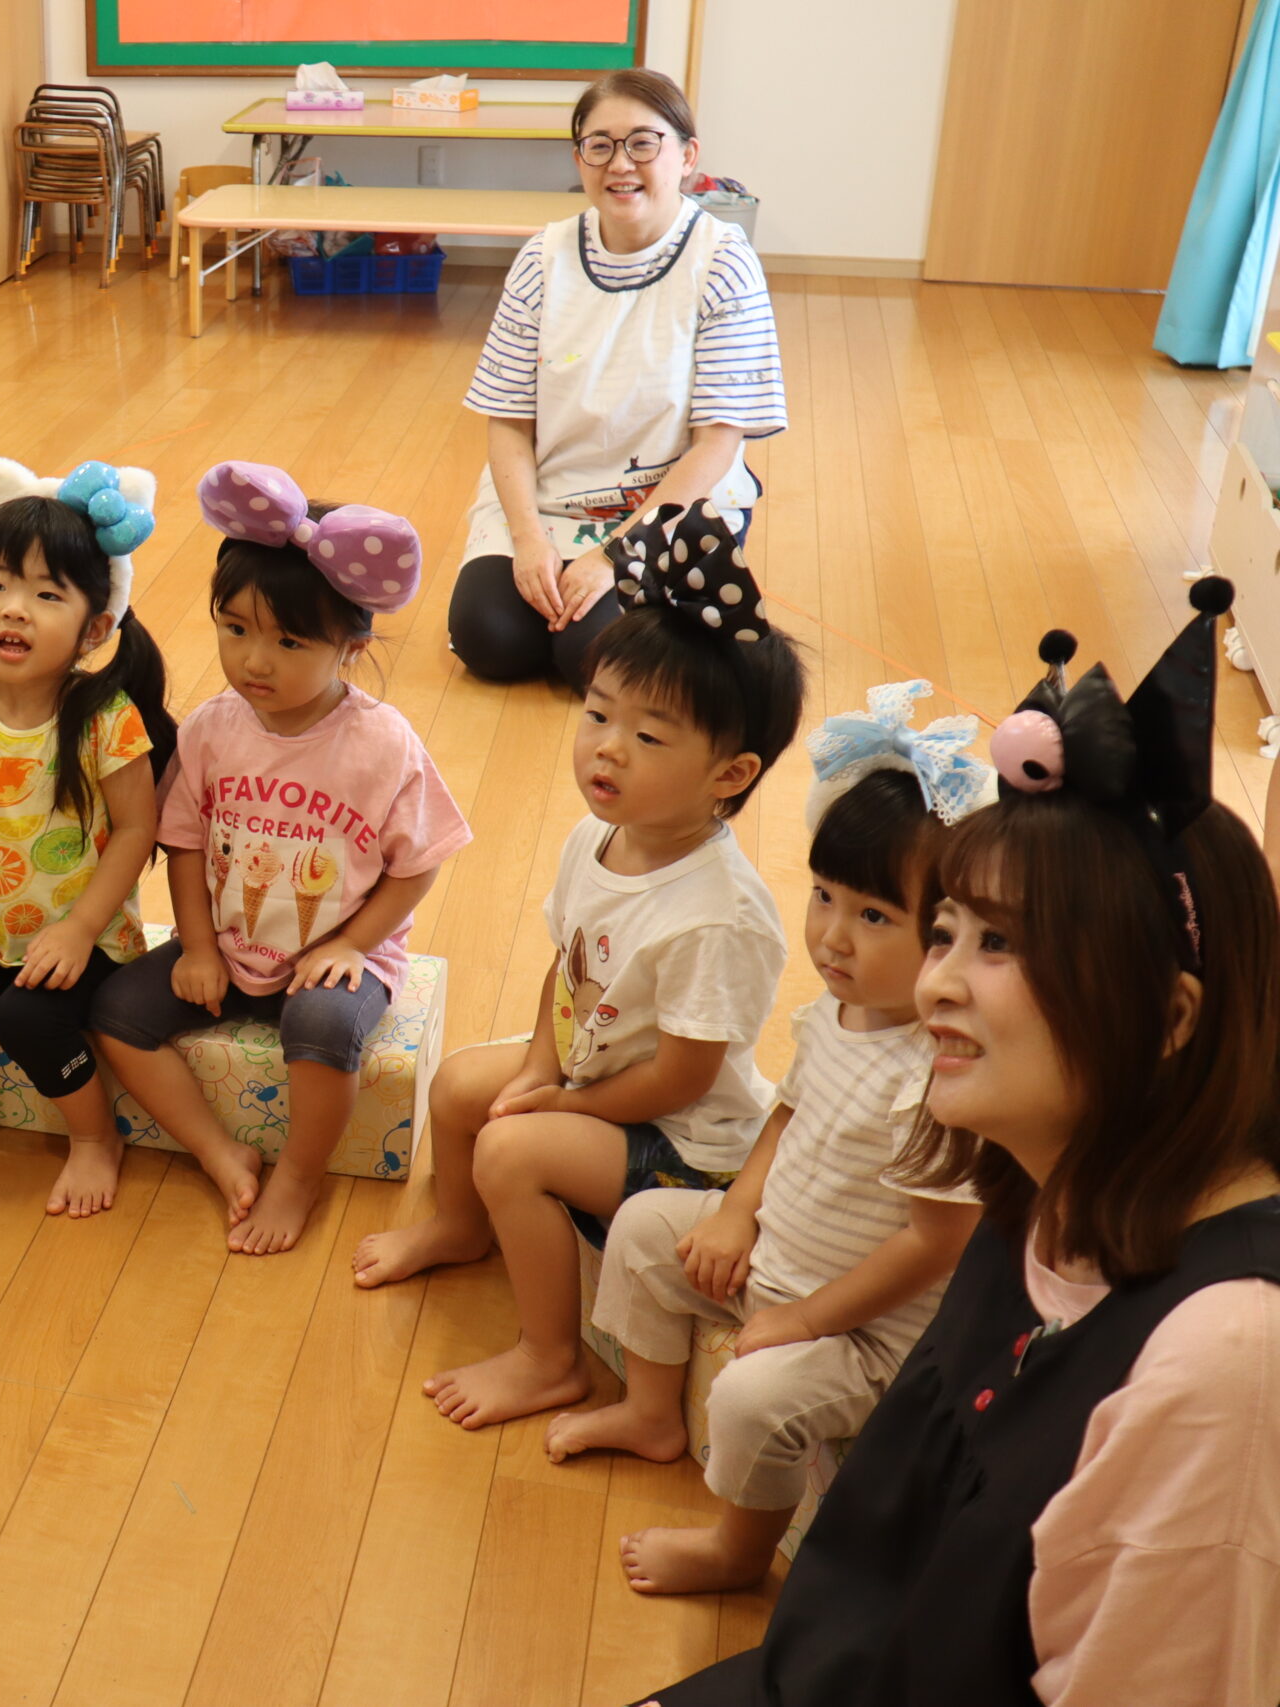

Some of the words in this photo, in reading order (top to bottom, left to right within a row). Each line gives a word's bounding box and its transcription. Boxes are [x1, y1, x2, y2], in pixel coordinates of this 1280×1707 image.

[215, 808, 241, 830] ICE
[246, 815, 325, 844] CREAM
[219, 775, 377, 854] FAVORITE
